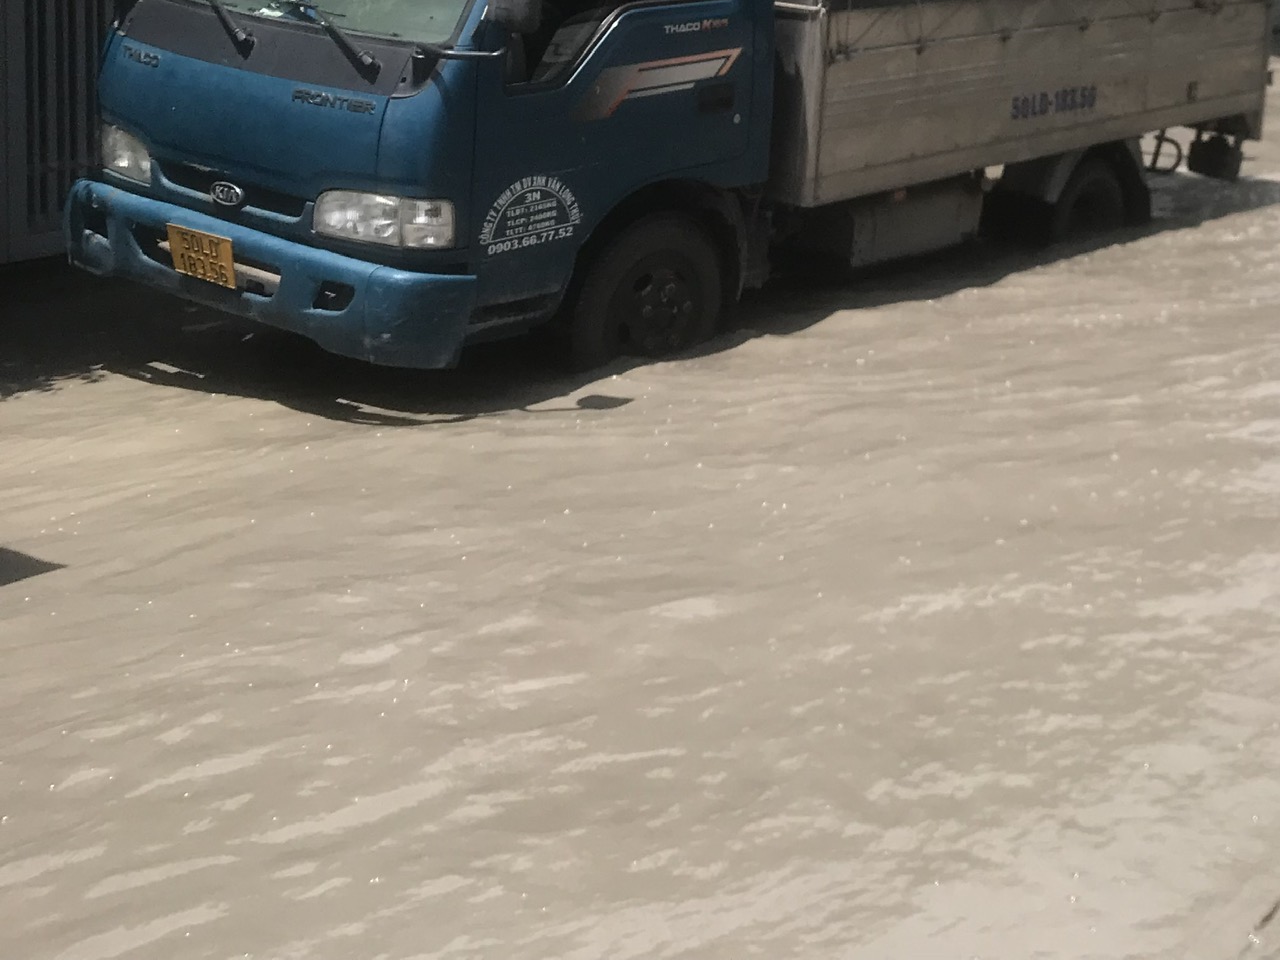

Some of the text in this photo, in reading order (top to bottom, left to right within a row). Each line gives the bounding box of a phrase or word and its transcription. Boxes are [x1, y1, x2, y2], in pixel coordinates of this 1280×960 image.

[664, 22, 701, 34] THACO
[291, 89, 376, 115] FRONTIER
[215, 185, 238, 202] KIA
[524, 191, 541, 203] 3N
[486, 209, 498, 222] TY
[493, 190, 513, 210] TNHH
